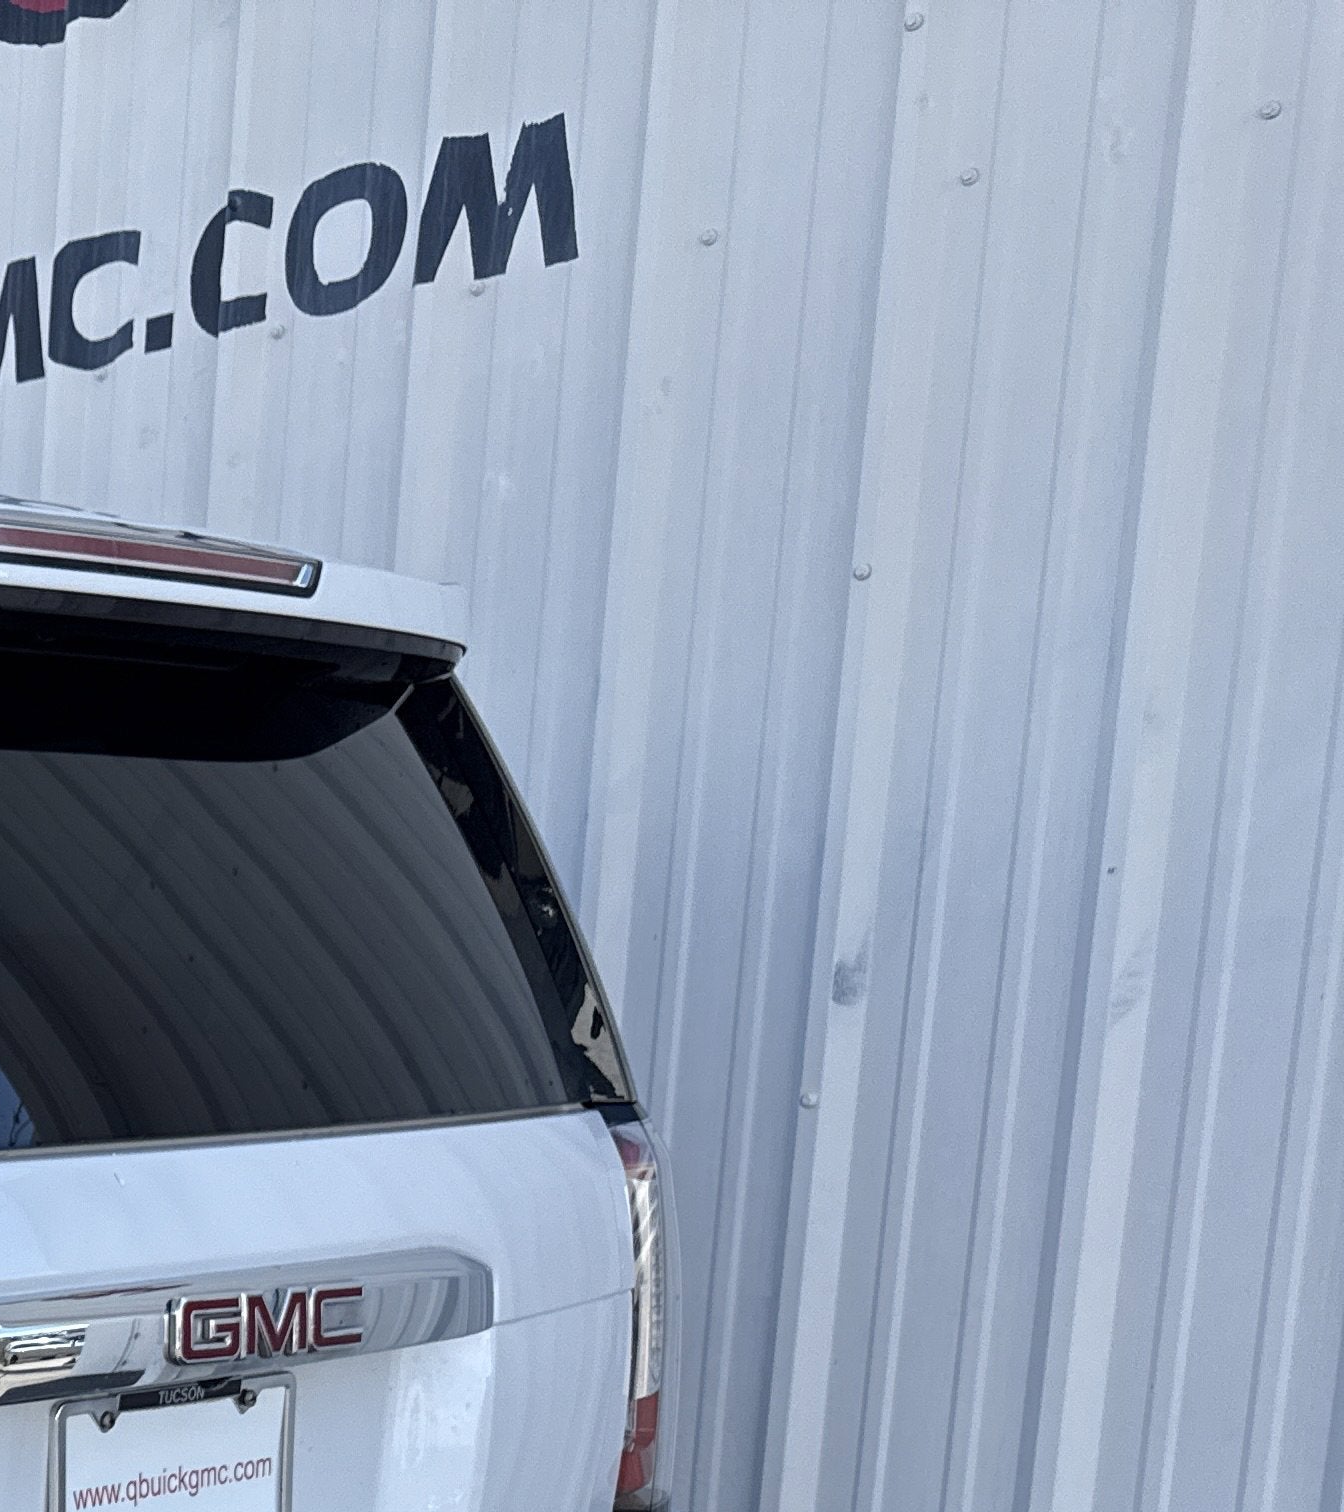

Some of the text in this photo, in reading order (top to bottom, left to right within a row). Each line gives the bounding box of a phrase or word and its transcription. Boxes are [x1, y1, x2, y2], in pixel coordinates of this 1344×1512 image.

[166, 1286, 364, 1365] GMC
[159, 1386, 205, 1405] TUCSON
[72, 1456, 273, 1511] www.qbuickgmc.com
